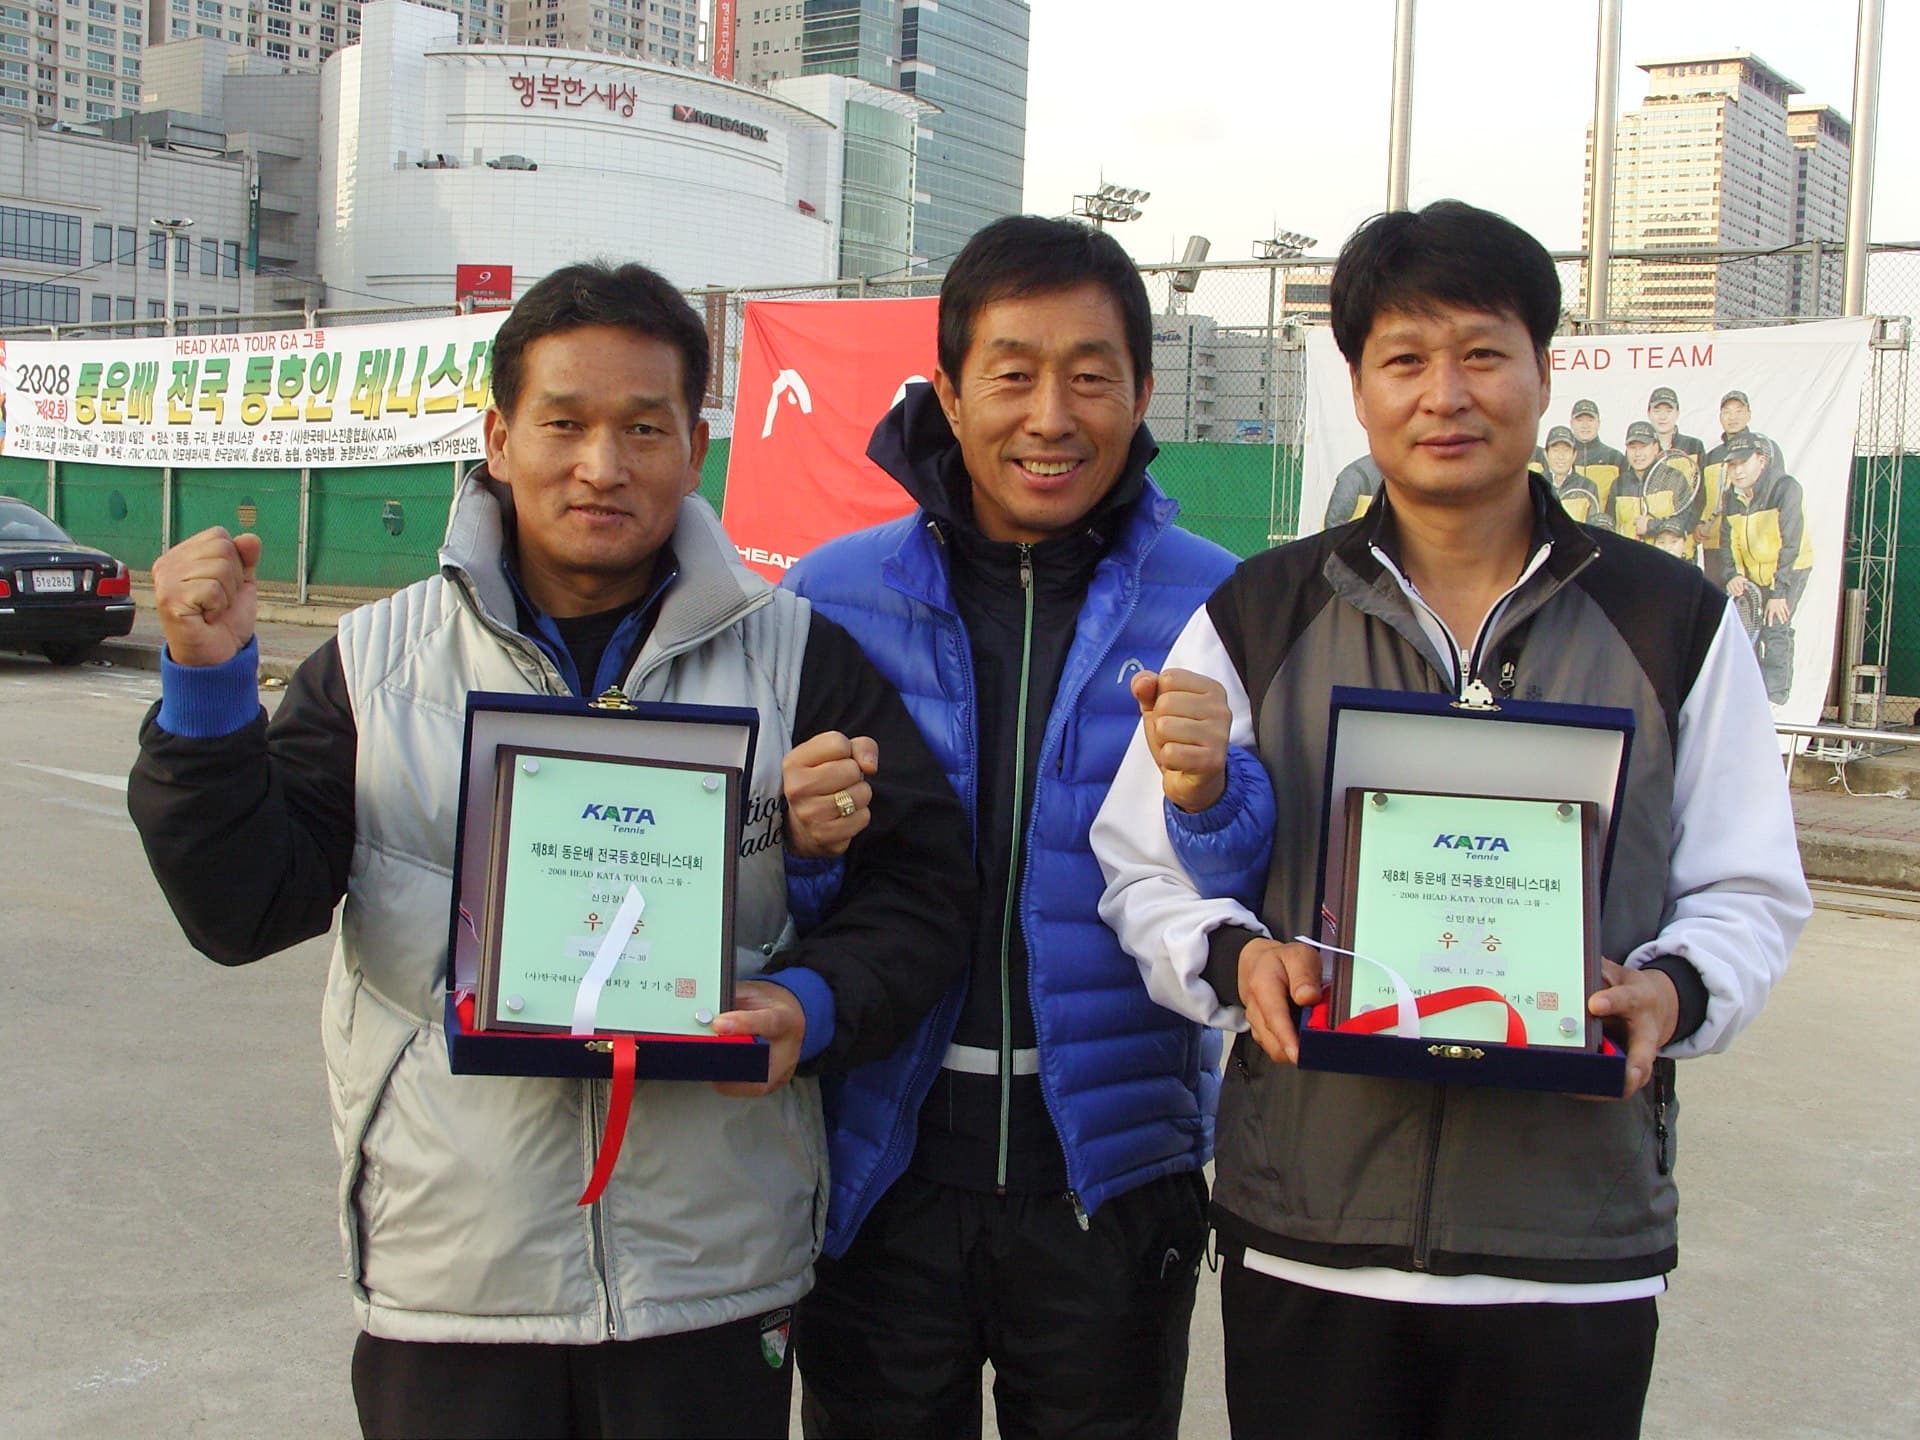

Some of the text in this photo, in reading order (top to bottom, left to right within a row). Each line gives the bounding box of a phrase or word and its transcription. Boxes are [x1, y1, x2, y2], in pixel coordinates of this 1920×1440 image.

[508, 71, 638, 118] 행복한세상
[696, 109, 769, 143] MEGABOX
[176, 330, 325, 355] HEAD KATA TOUR GA 그룹
[1551, 344, 1713, 370] EAD TEAM
[16, 364, 70, 395] 2008
[75, 339, 495, 426] 동운배 전국 동호인 테니스대
[157, 431, 169, 445] 장소
[211, 431, 225, 446] 부천
[227, 431, 255, 445] 테니스장
[269, 430, 283, 445] 주관
[581, 803, 656, 825] KATA
[613, 824, 645, 835] Tennis
[1432, 833, 1510, 852] KATA
[531, 842, 703, 871] 제8회 동운배 전국동호인테니스대회
[1465, 852, 1500, 861] Tennis
[547, 867, 567, 876] 2008
[569, 869, 594, 879] HEAD
[596, 871, 621, 881] KATA
[624, 873, 648, 884] TOUR
[650, 876, 663, 885] GA
[1382, 869, 1561, 892] 제8회 동운배 전국동호인테니스대회
[1399, 891, 1420, 900] 2008
[1422, 893, 1447, 901] HEAD
[1450, 894, 1476, 903] KATA
[1479, 896, 1504, 905] TOUR
[1506, 898, 1520, 906] GA
